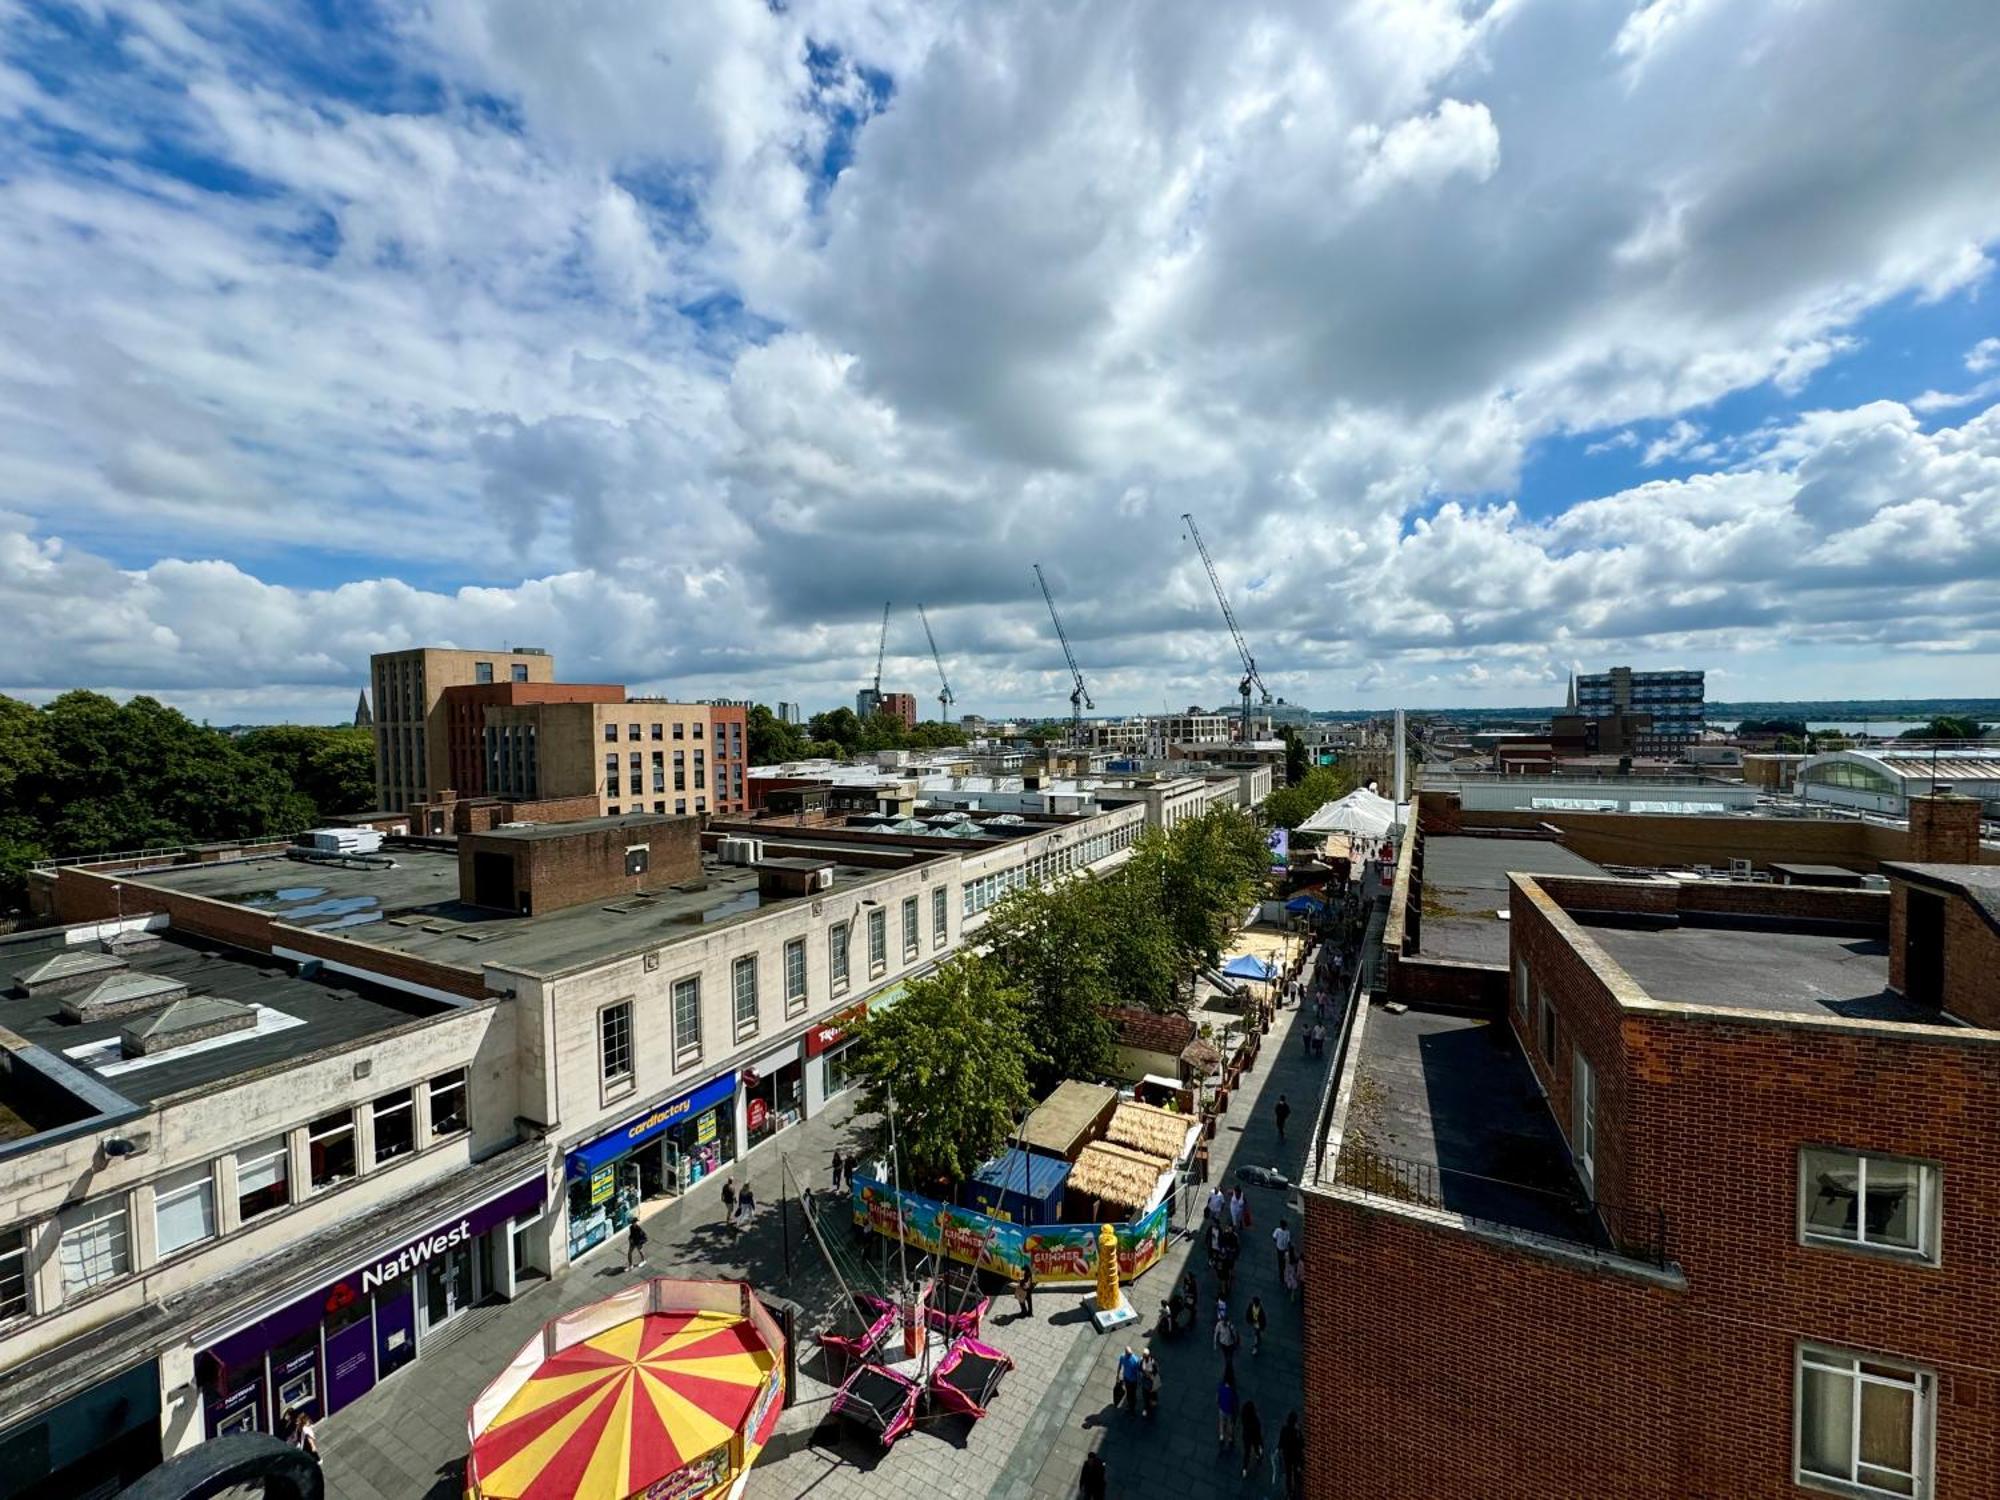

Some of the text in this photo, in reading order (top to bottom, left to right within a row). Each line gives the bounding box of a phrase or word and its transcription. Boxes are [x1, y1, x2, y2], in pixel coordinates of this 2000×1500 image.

[628, 1099, 691, 1138] cardfactory
[362, 1219, 471, 1294] NatWest
[1034, 1251, 1080, 1262] SUMMER
